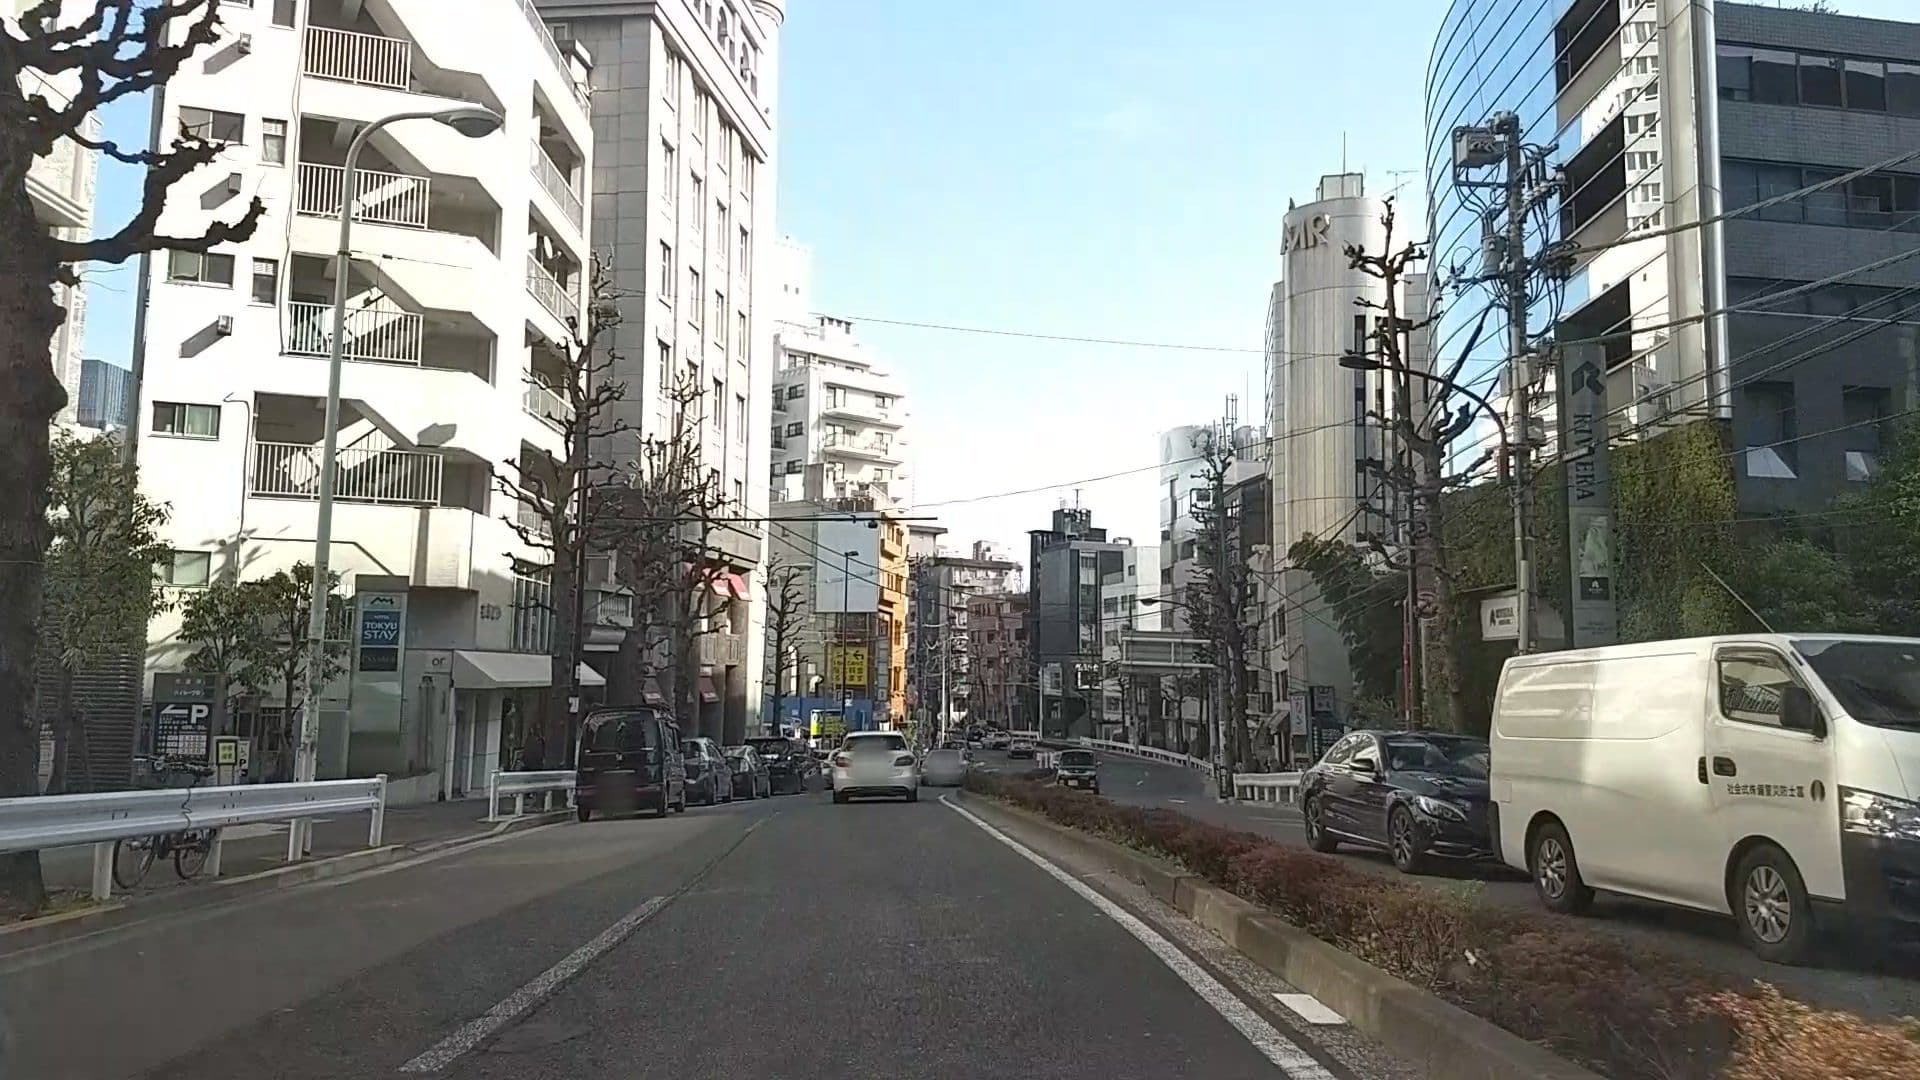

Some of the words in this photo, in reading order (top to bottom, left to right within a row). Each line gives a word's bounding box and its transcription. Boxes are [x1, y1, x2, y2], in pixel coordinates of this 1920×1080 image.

[364, 621, 398, 630] TOKYU
[364, 630, 398, 641] STAY
[191, 704, 209, 724] P
